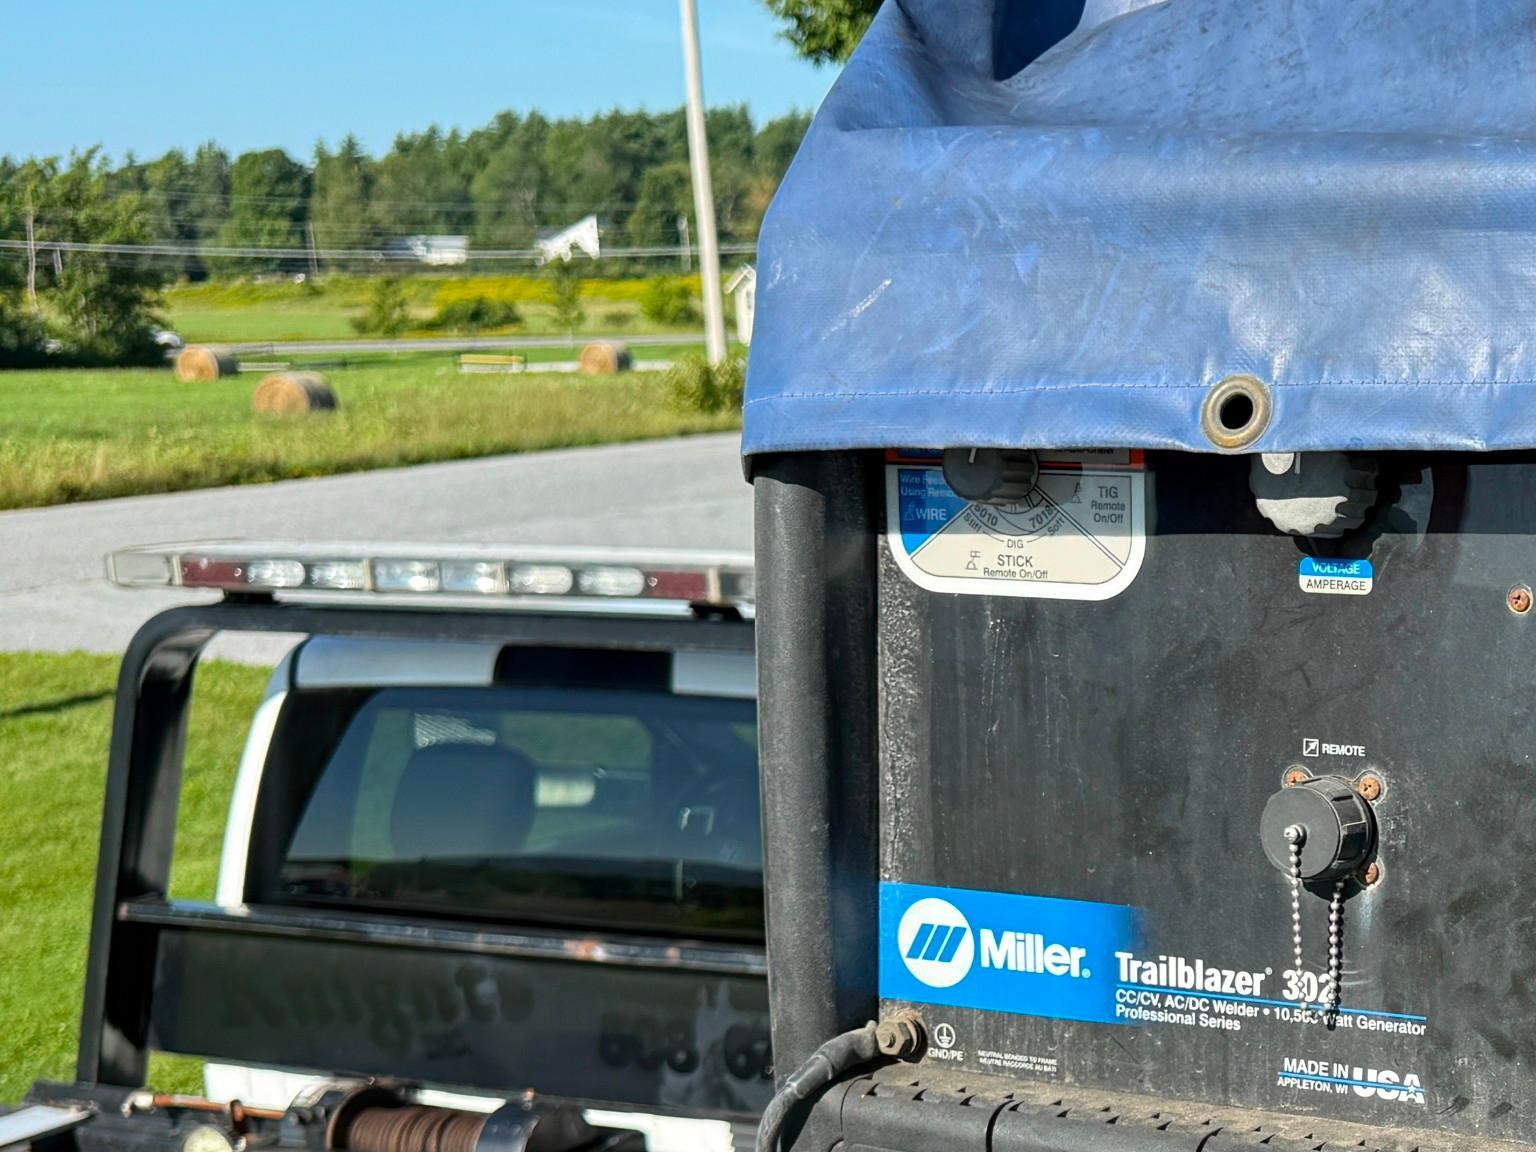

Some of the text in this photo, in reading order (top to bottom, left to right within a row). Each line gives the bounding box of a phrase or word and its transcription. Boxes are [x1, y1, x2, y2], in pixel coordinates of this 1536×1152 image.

[1097, 486, 1119, 499] TIG
[1090, 501, 1126, 512] Remote
[915, 507, 948, 521] WIRE
[1093, 512, 1124, 525] On/Off
[1046, 515, 1067, 537] Soft
[1006, 537, 1025, 549] DIG
[996, 553, 1034, 568] STICK
[983, 567, 1049, 580] Remote On/Off
[1311, 561, 1361, 575] VOLTAGE
[1306, 579, 1367, 591] AMPERAGE
[1321, 743, 1367, 757] REMOTE
[1115, 988, 1162, 1008] CC/CV,
[1165, 994, 1210, 1012] AC/DC
[1212, 999, 1260, 1018] Welder
[1356, 1014, 1427, 1036] Generator
[1116, 1004, 1241, 1031] Professional Series
[927, 1047, 964, 1062] GND/PE
[1029, 1055, 1038, 1063] TO
[1283, 1057, 1426, 1104] MADE IN USA
[1335, 1084, 1348, 1095] WI
